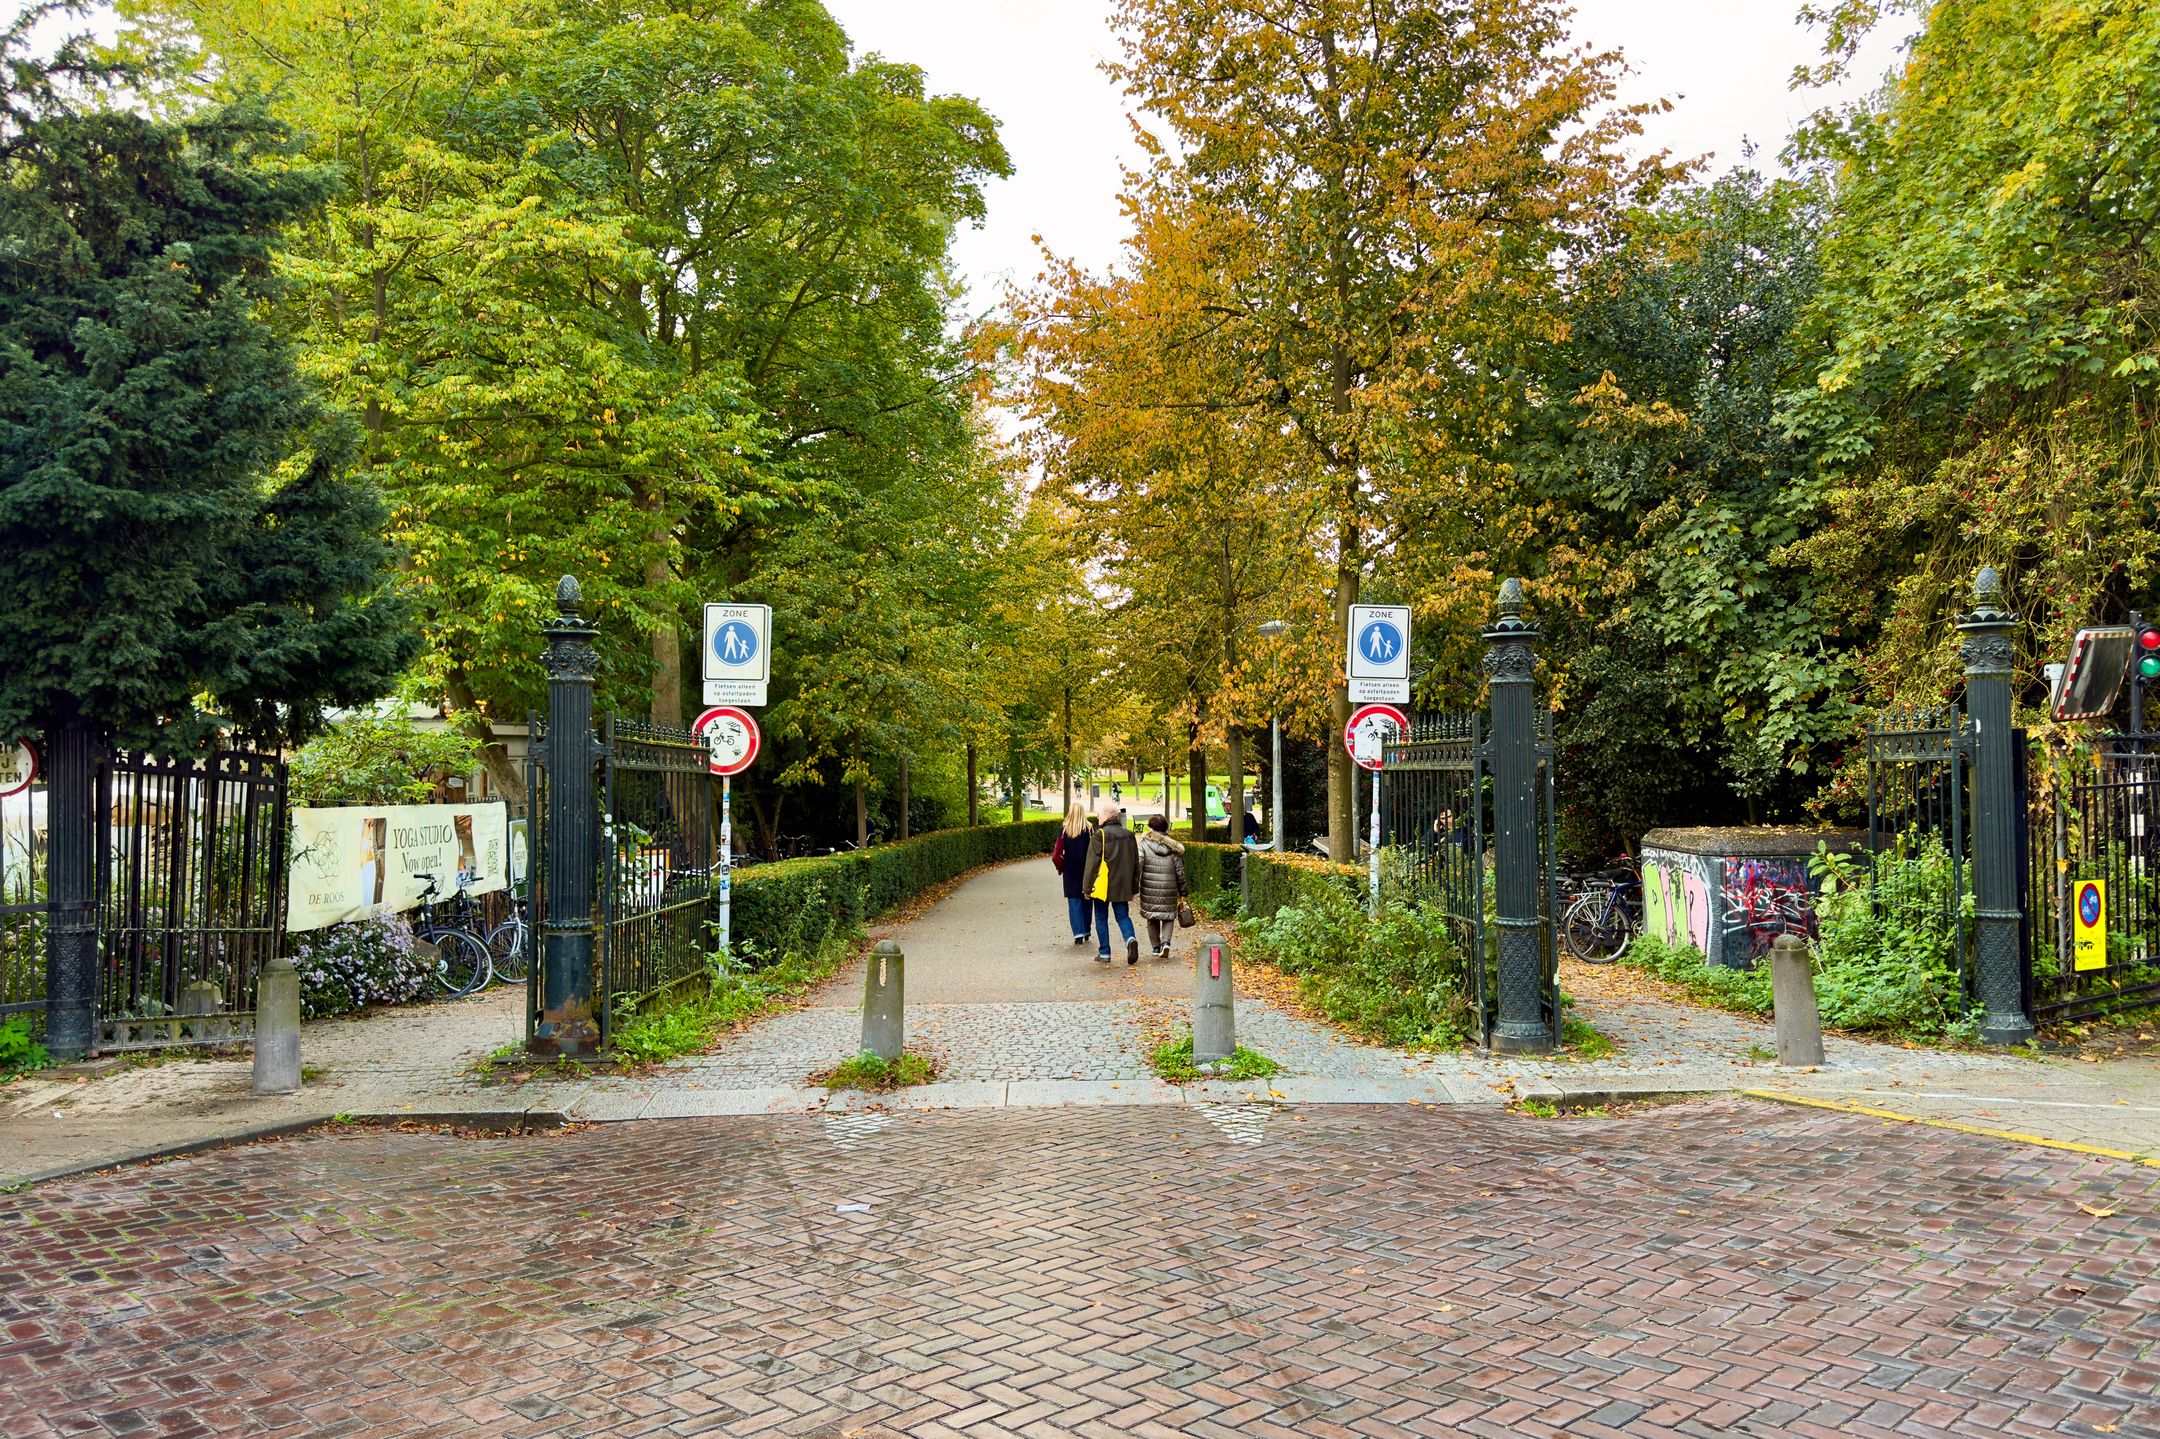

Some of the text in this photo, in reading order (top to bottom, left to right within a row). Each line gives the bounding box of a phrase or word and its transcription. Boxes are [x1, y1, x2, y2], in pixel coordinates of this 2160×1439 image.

[722, 610, 748, 618] ZONE
[1368, 610, 1393, 618] ZONE
[394, 824, 453, 849] YOGA STUDIO
[401, 848, 442, 874] Now open!
[308, 891, 344, 905] DE ROOS
